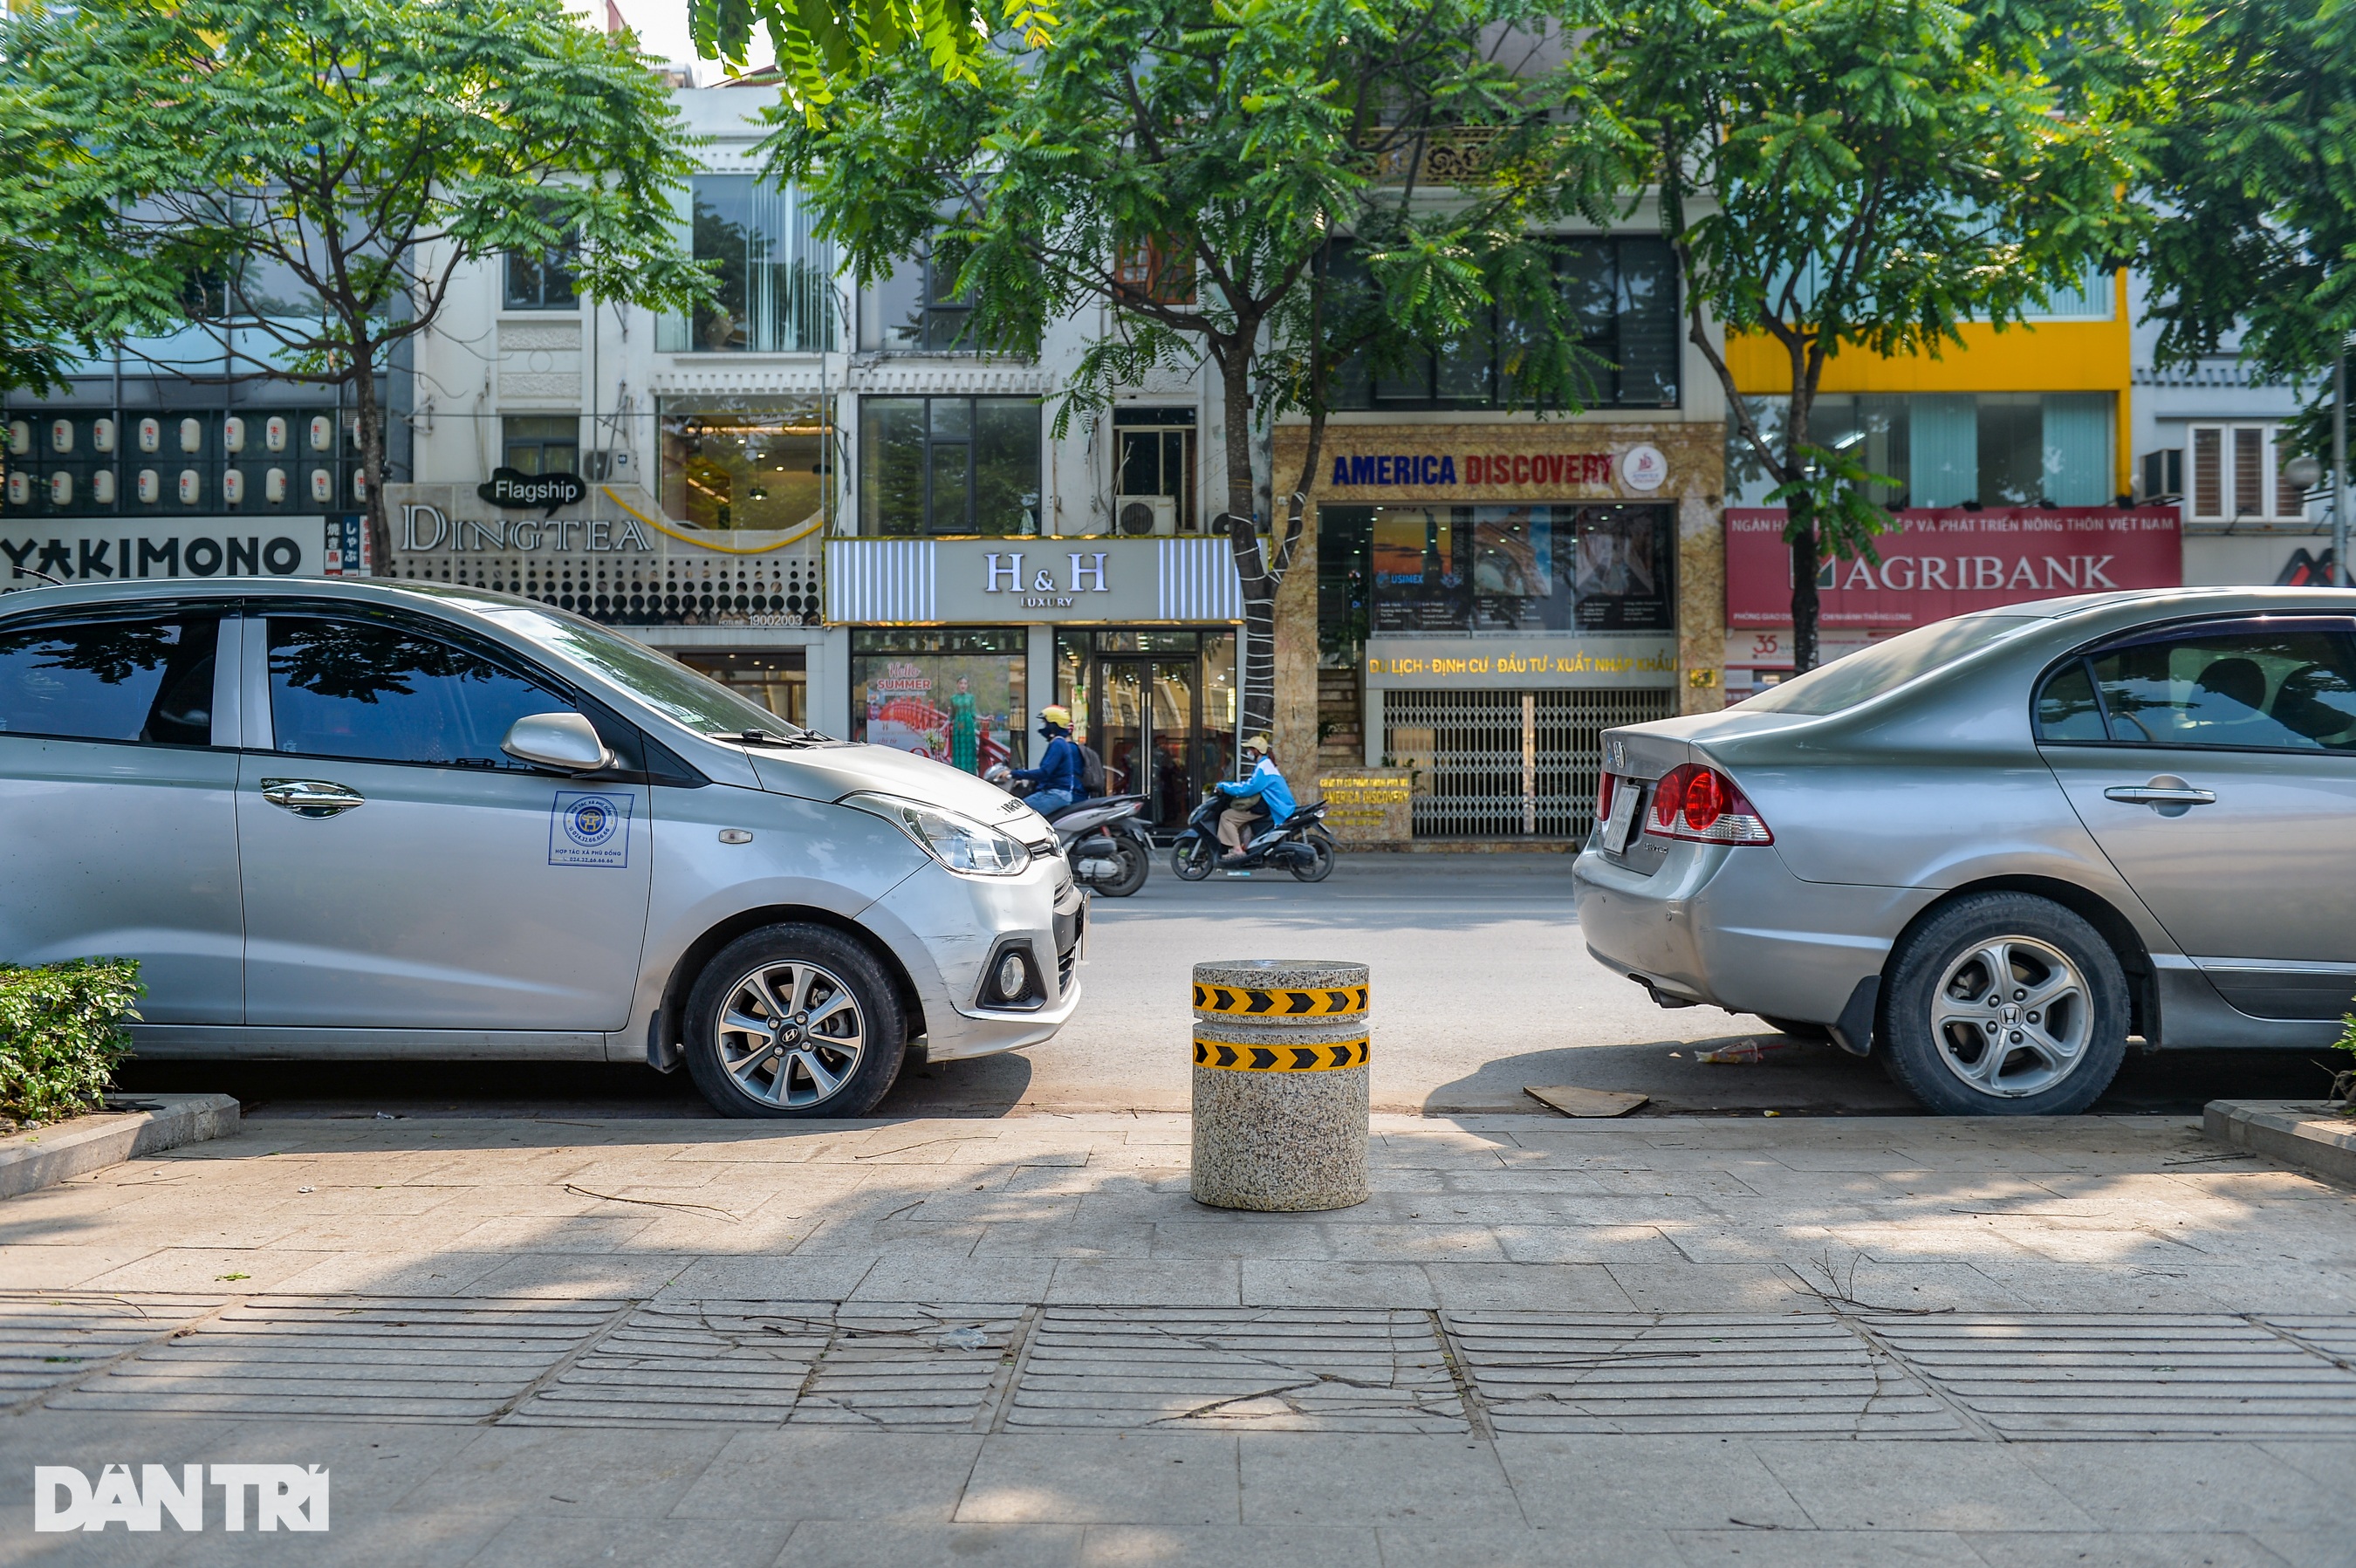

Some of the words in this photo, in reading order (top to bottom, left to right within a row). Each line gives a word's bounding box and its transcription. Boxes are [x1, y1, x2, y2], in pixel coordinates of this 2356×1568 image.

[1332, 455, 1456, 485] AMERICA
[1465, 454, 1614, 485] DISCOVERY
[496, 481, 578, 502] Flagship
[401, 504, 653, 551] DINGTEA
[1731, 517, 1770, 532] NGÂN
[1916, 517, 1936, 532] VÀ
[1940, 516, 1975, 532] PHÁT
[1980, 515, 2018, 532] TRIỂN
[2023, 517, 2063, 532] NÔNG
[2067, 517, 2104, 531] THÔN
[2107, 517, 2138, 533] VIỆT
[2140, 517, 2174, 531] NAM
[1, 537, 302, 579] YAKIMONO
[984, 553, 1025, 592] H
[1034, 569, 1057, 592] &
[1067, 553, 1109, 592] H
[1391, 574, 1423, 584] USIMEX
[1842, 555, 2119, 590] AGRIBANK
[1020, 597, 1073, 607] LUXURY
[749, 614, 802, 627] 19002003
[1753, 634, 1777, 654] 35
[887, 662, 921, 678] Hello
[1369, 659, 1387, 673] DU
[1391, 659, 1422, 677] LỊCH
[1432, 659, 1466, 677] ĐỊNH
[1469, 656, 1490, 673] CƯ
[1496, 651, 1526, 673] ĐẦU
[1529, 655, 1548, 673] TƯ
[1556, 650, 1592, 672] XUẤT
[1595, 656, 1633, 675] NHẬP
[1636, 649, 1677, 672] KHẨU
[877, 679, 931, 689] SUMMER
[1323, 791, 1359, 804] AMERICA
[1363, 791, 1409, 804] DISCOVERY
[572, 828, 610, 843] 024.32.66.66.66
